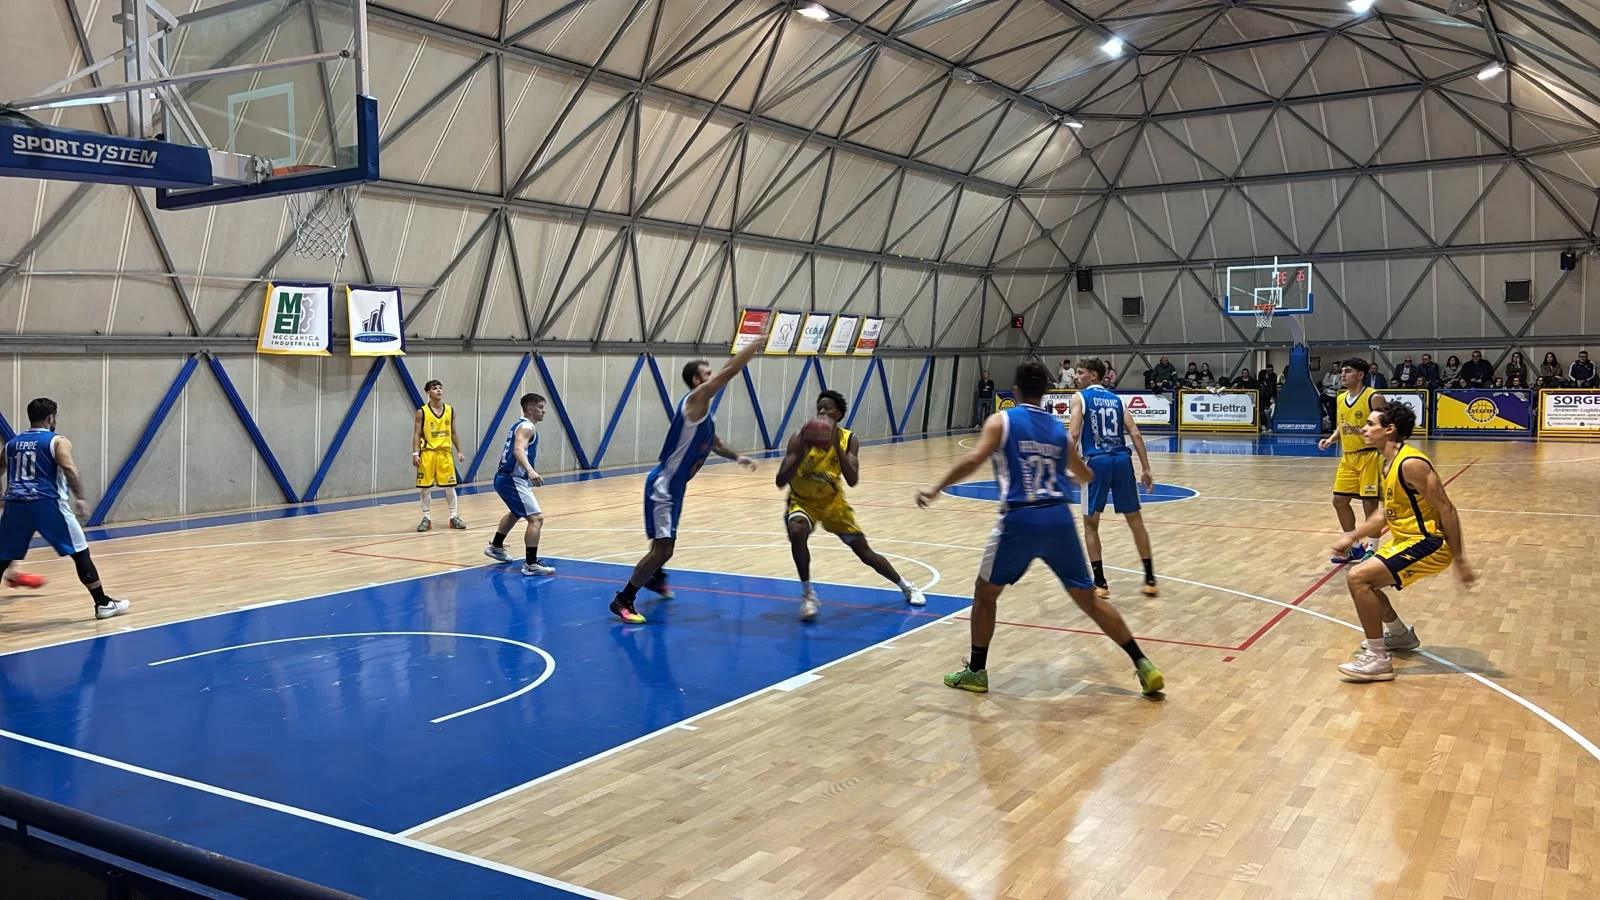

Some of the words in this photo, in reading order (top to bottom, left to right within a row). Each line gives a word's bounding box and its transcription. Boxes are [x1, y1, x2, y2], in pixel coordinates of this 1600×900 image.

[12, 134, 80, 156] SPORT
[81, 142, 158, 164] SYSTEM
[1098, 407, 1119, 436] 13
[1212, 403, 1247, 413] Elettra
[15, 450, 37, 481] 10
